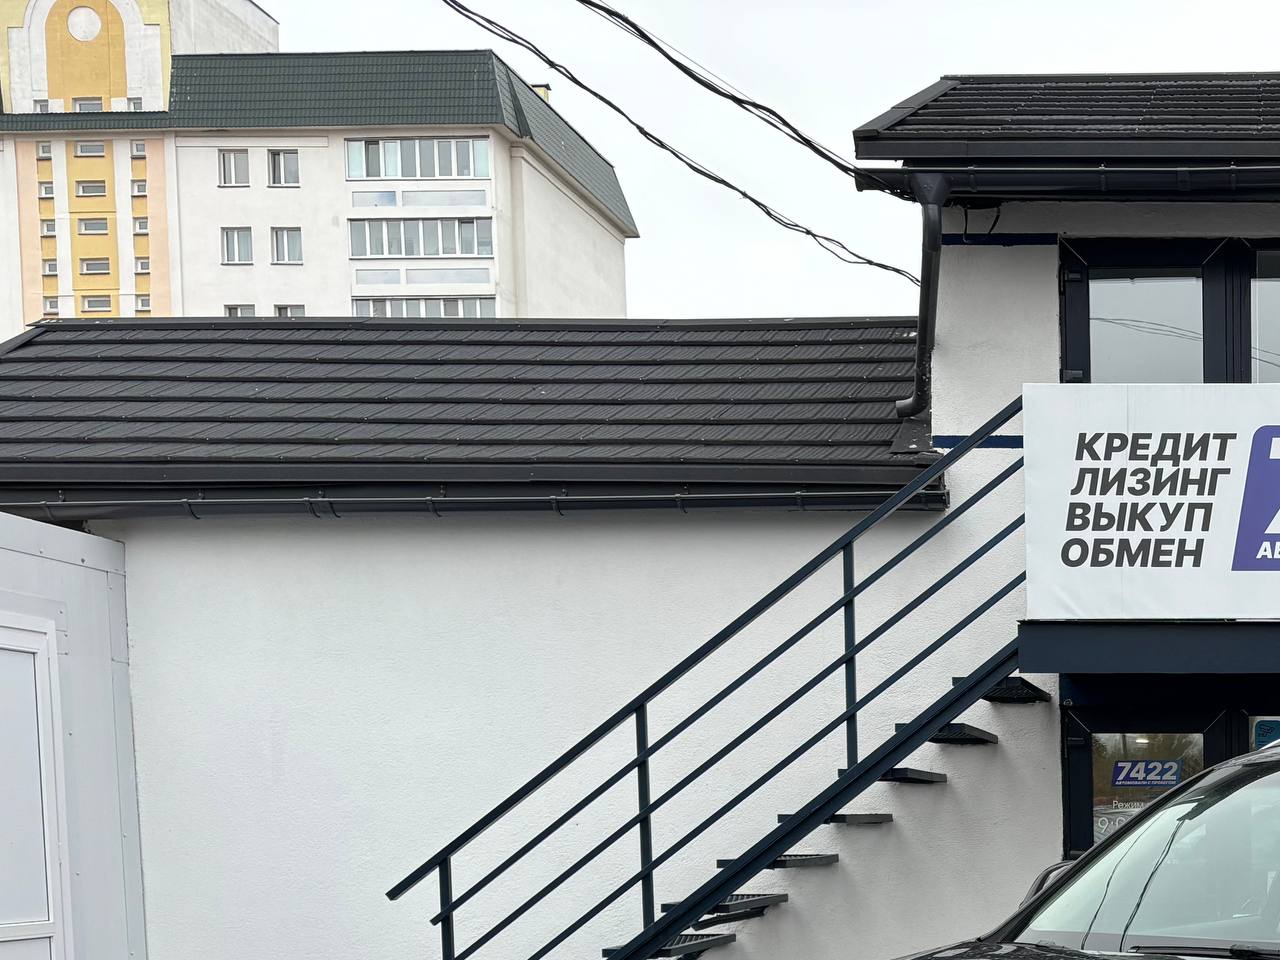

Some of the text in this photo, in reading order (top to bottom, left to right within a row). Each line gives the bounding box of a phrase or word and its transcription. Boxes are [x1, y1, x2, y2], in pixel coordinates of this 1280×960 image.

[1075, 433, 1237, 467] КРЕДИТ
[1070, 468, 1231, 496] ЛИЗИНГ
[1065, 502, 1213, 532] ВЫКУП
[1060, 538, 1205, 568] ОБМЕН
[1117, 761, 1178, 780] 7422
